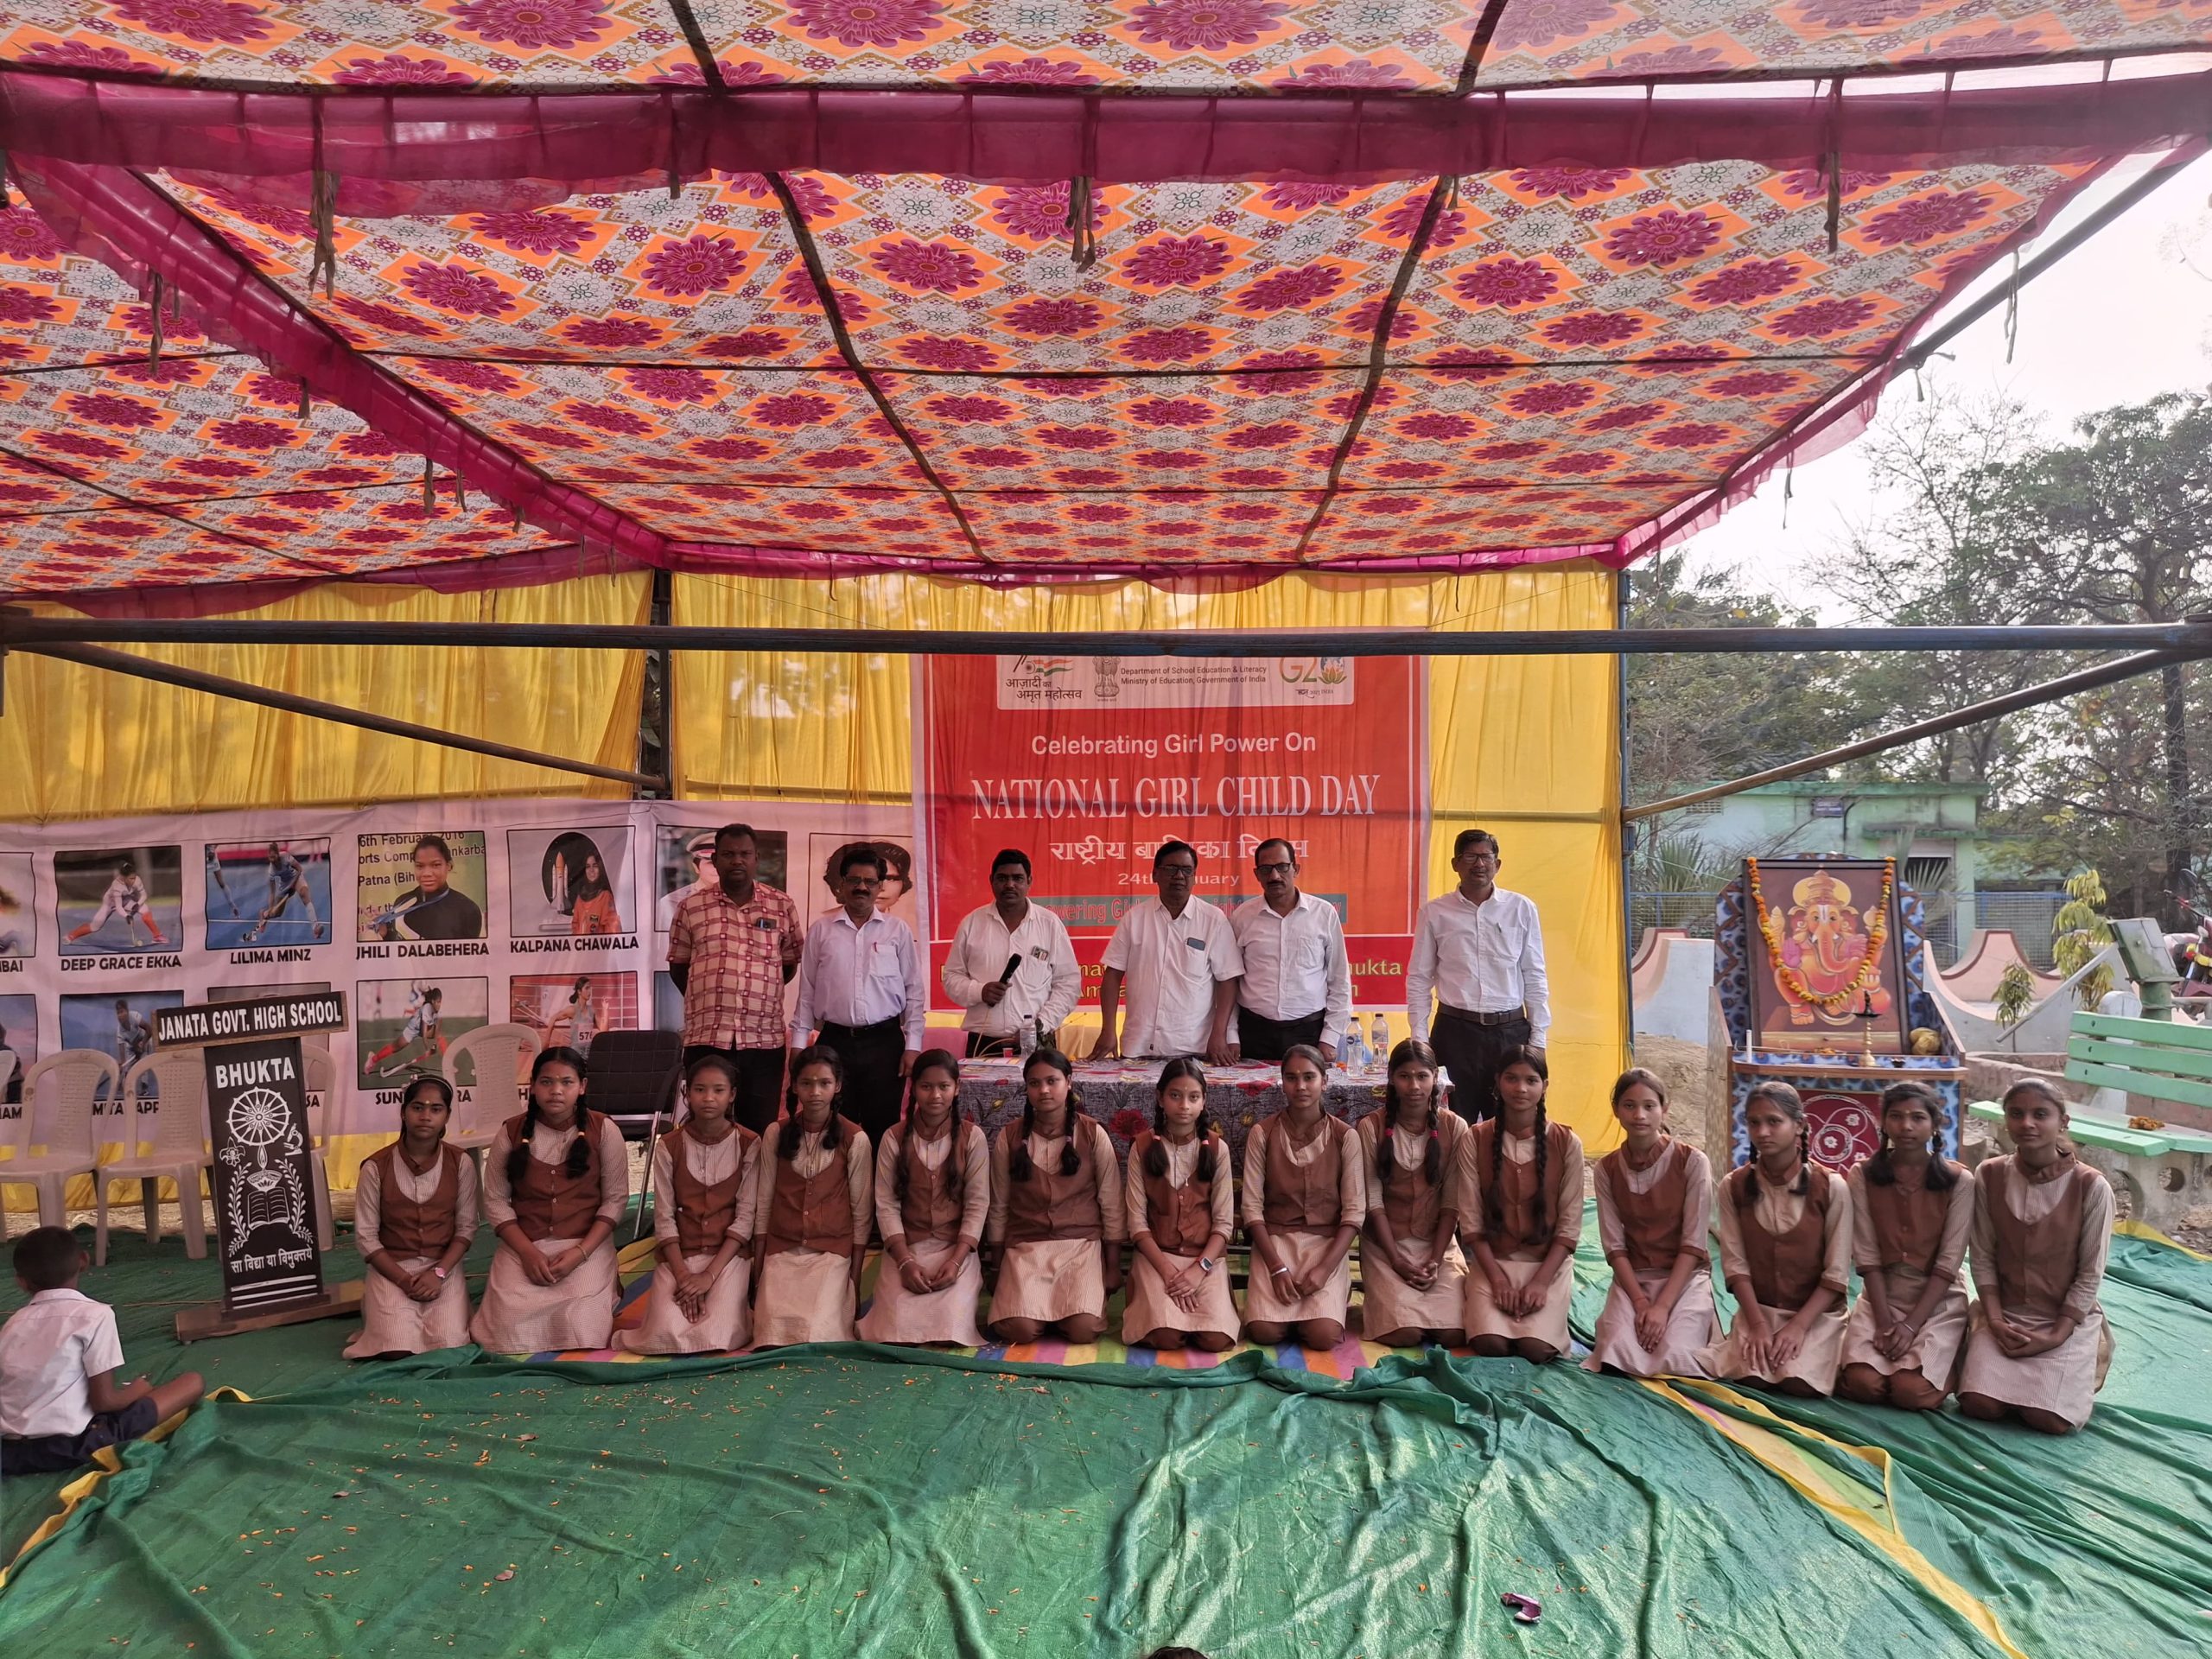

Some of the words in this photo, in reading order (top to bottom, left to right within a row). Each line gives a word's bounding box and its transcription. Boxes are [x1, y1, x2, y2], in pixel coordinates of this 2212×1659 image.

[1005, 676, 1041, 689] आज़ादी
[1160, 677, 1195, 685] Education,
[1016, 689, 1041, 702] अमृत
[1044, 687, 1083, 701] महोत्सव
[1031, 734, 1158, 759] Celebrating
[1165, 734, 1203, 753] Girl
[1210, 733, 1280, 753] Power
[1285, 732, 1316, 752] On
[970, 778, 1127, 819] NATIONAL
[1135, 777, 1209, 818] GIRL
[1216, 776, 1312, 817] CHILD
[1319, 774, 1381, 816] DAY
[1049, 835, 1127, 864] राष्ट्रीय
[359, 874, 391, 887] Patna
[356, 945, 390, 960] JHILI
[397, 943, 490, 957] DALABEHERA
[510, 938, 571, 953] KALPANA
[574, 936, 639, 950] CHAWALA
[60, 958, 96, 971] DEEP
[99, 957, 143, 970] GRACE
[146, 955, 182, 969] EKKA
[230, 950, 274, 964] LILIMA
[276, 949, 311, 963] MINZ
[159, 1013, 209, 1041] JANATA
[212, 1008, 251, 1035] GOVT.
[253, 1004, 287, 1031] HIGH
[289, 1001, 342, 1027] SCHOOL
[215, 1057, 296, 1089] BHUKTA
[230, 1260, 243, 1273] सा
[244, 1254, 264, 1272] विद्या
[266, 1254, 276, 1267] या
[278, 1244, 313, 1268] विमुक्तये
